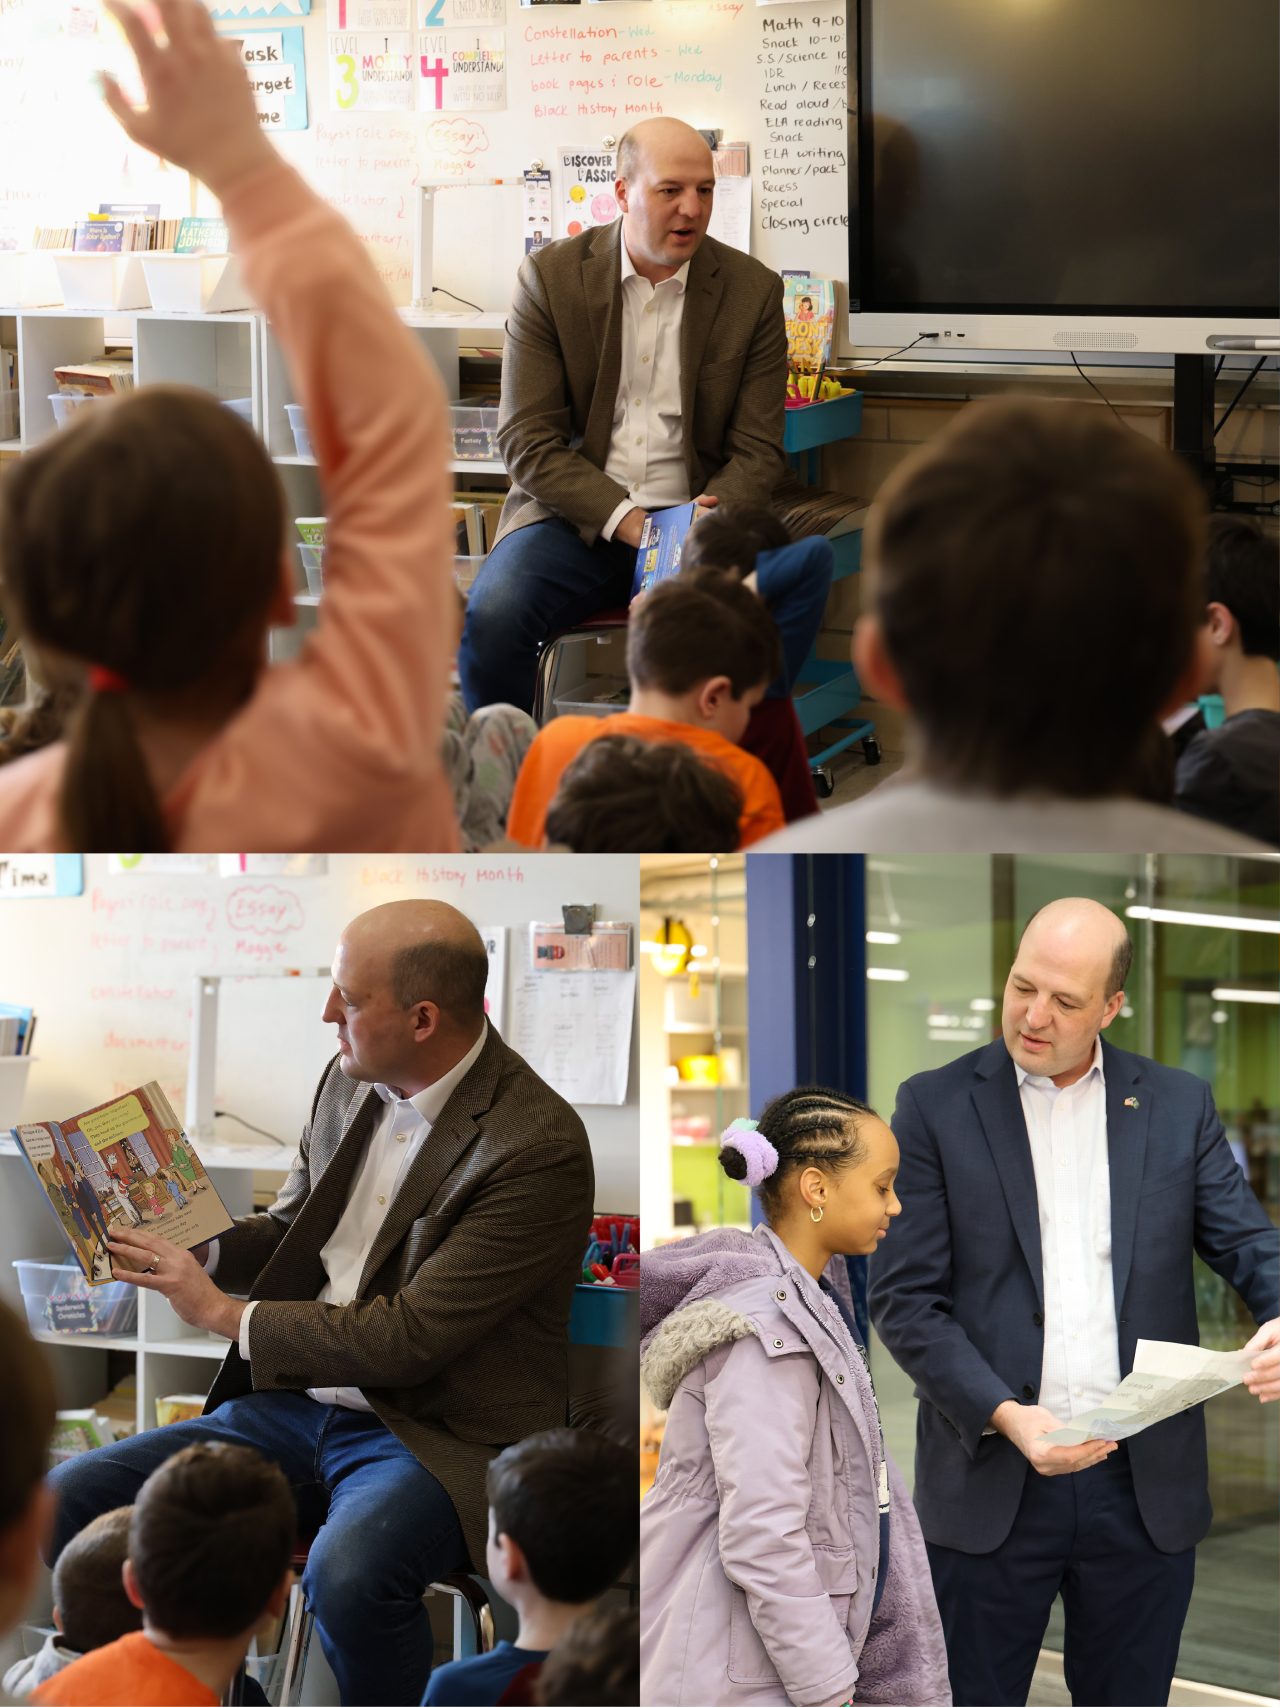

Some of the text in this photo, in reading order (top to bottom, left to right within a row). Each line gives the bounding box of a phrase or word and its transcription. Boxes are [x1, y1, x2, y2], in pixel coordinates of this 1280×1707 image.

[762, 16, 844, 32] Math 9-10
[525, 26, 618, 42] Constellation
[762, 37, 798, 49] Snack
[244, 46, 278, 62] ask
[530, 53, 572, 66] Letter
[580, 50, 592, 63] to
[603, 48, 658, 65] parents
[764, 67, 784, 78] IDR
[247, 77, 293, 94] arget
[336, 54, 360, 110] 3
[420, 55, 448, 110] 4
[531, 72, 722, 94] book pages role Monday
[765, 82, 796, 94] Lunch
[534, 102, 663, 118] Black History Month
[760, 98, 829, 110] Read aloud
[765, 117, 843, 130] ELA reading
[770, 132, 804, 143] Snack
[563, 155, 612, 168] DISCOVER
[764, 147, 846, 167] ELA writing
[762, 180, 798, 193] Recess
[760, 198, 803, 212] Special
[762, 214, 849, 234] Closing circle
[785, 322, 827, 338] FRONT
[788, 338, 822, 354] DESK
[416, 866, 468, 888] History
[476, 865, 524, 883] Month
